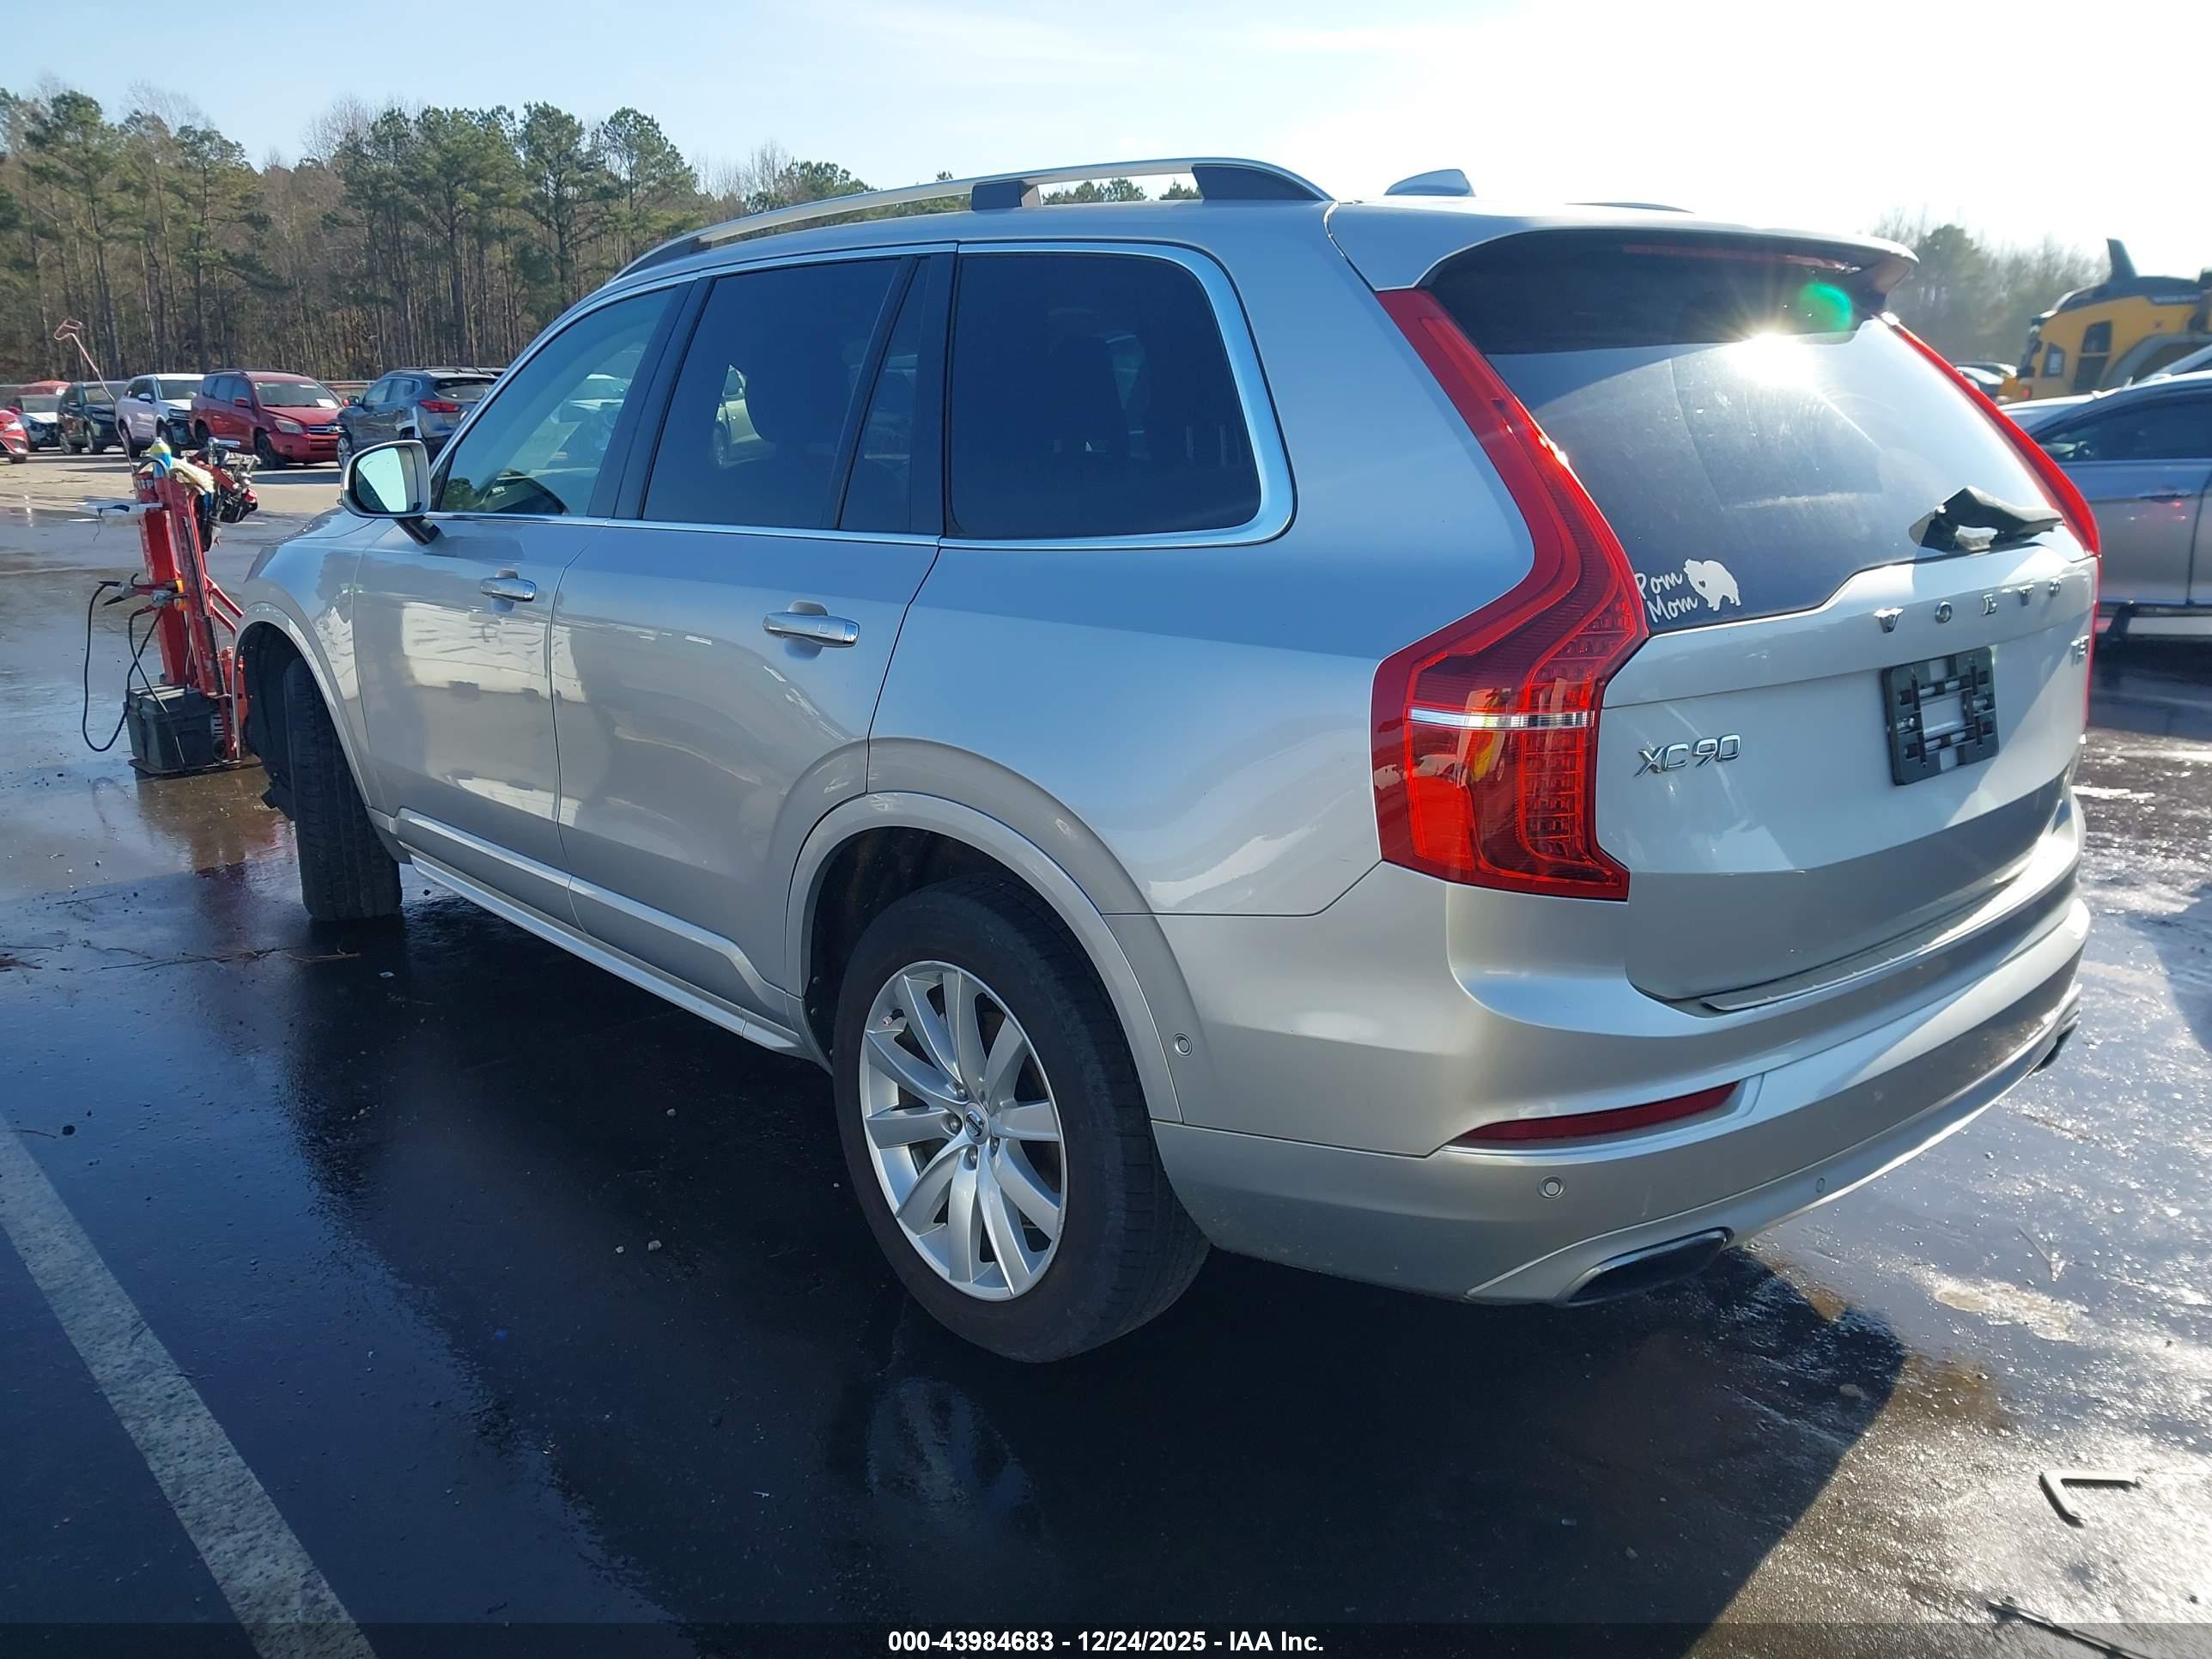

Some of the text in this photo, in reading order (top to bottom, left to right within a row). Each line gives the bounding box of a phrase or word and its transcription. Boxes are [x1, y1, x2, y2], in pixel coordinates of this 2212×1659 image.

[1633, 571, 1683, 600] Pom
[1646, 595, 1698, 623] Mom
[1634, 734, 1741, 777] XC90
